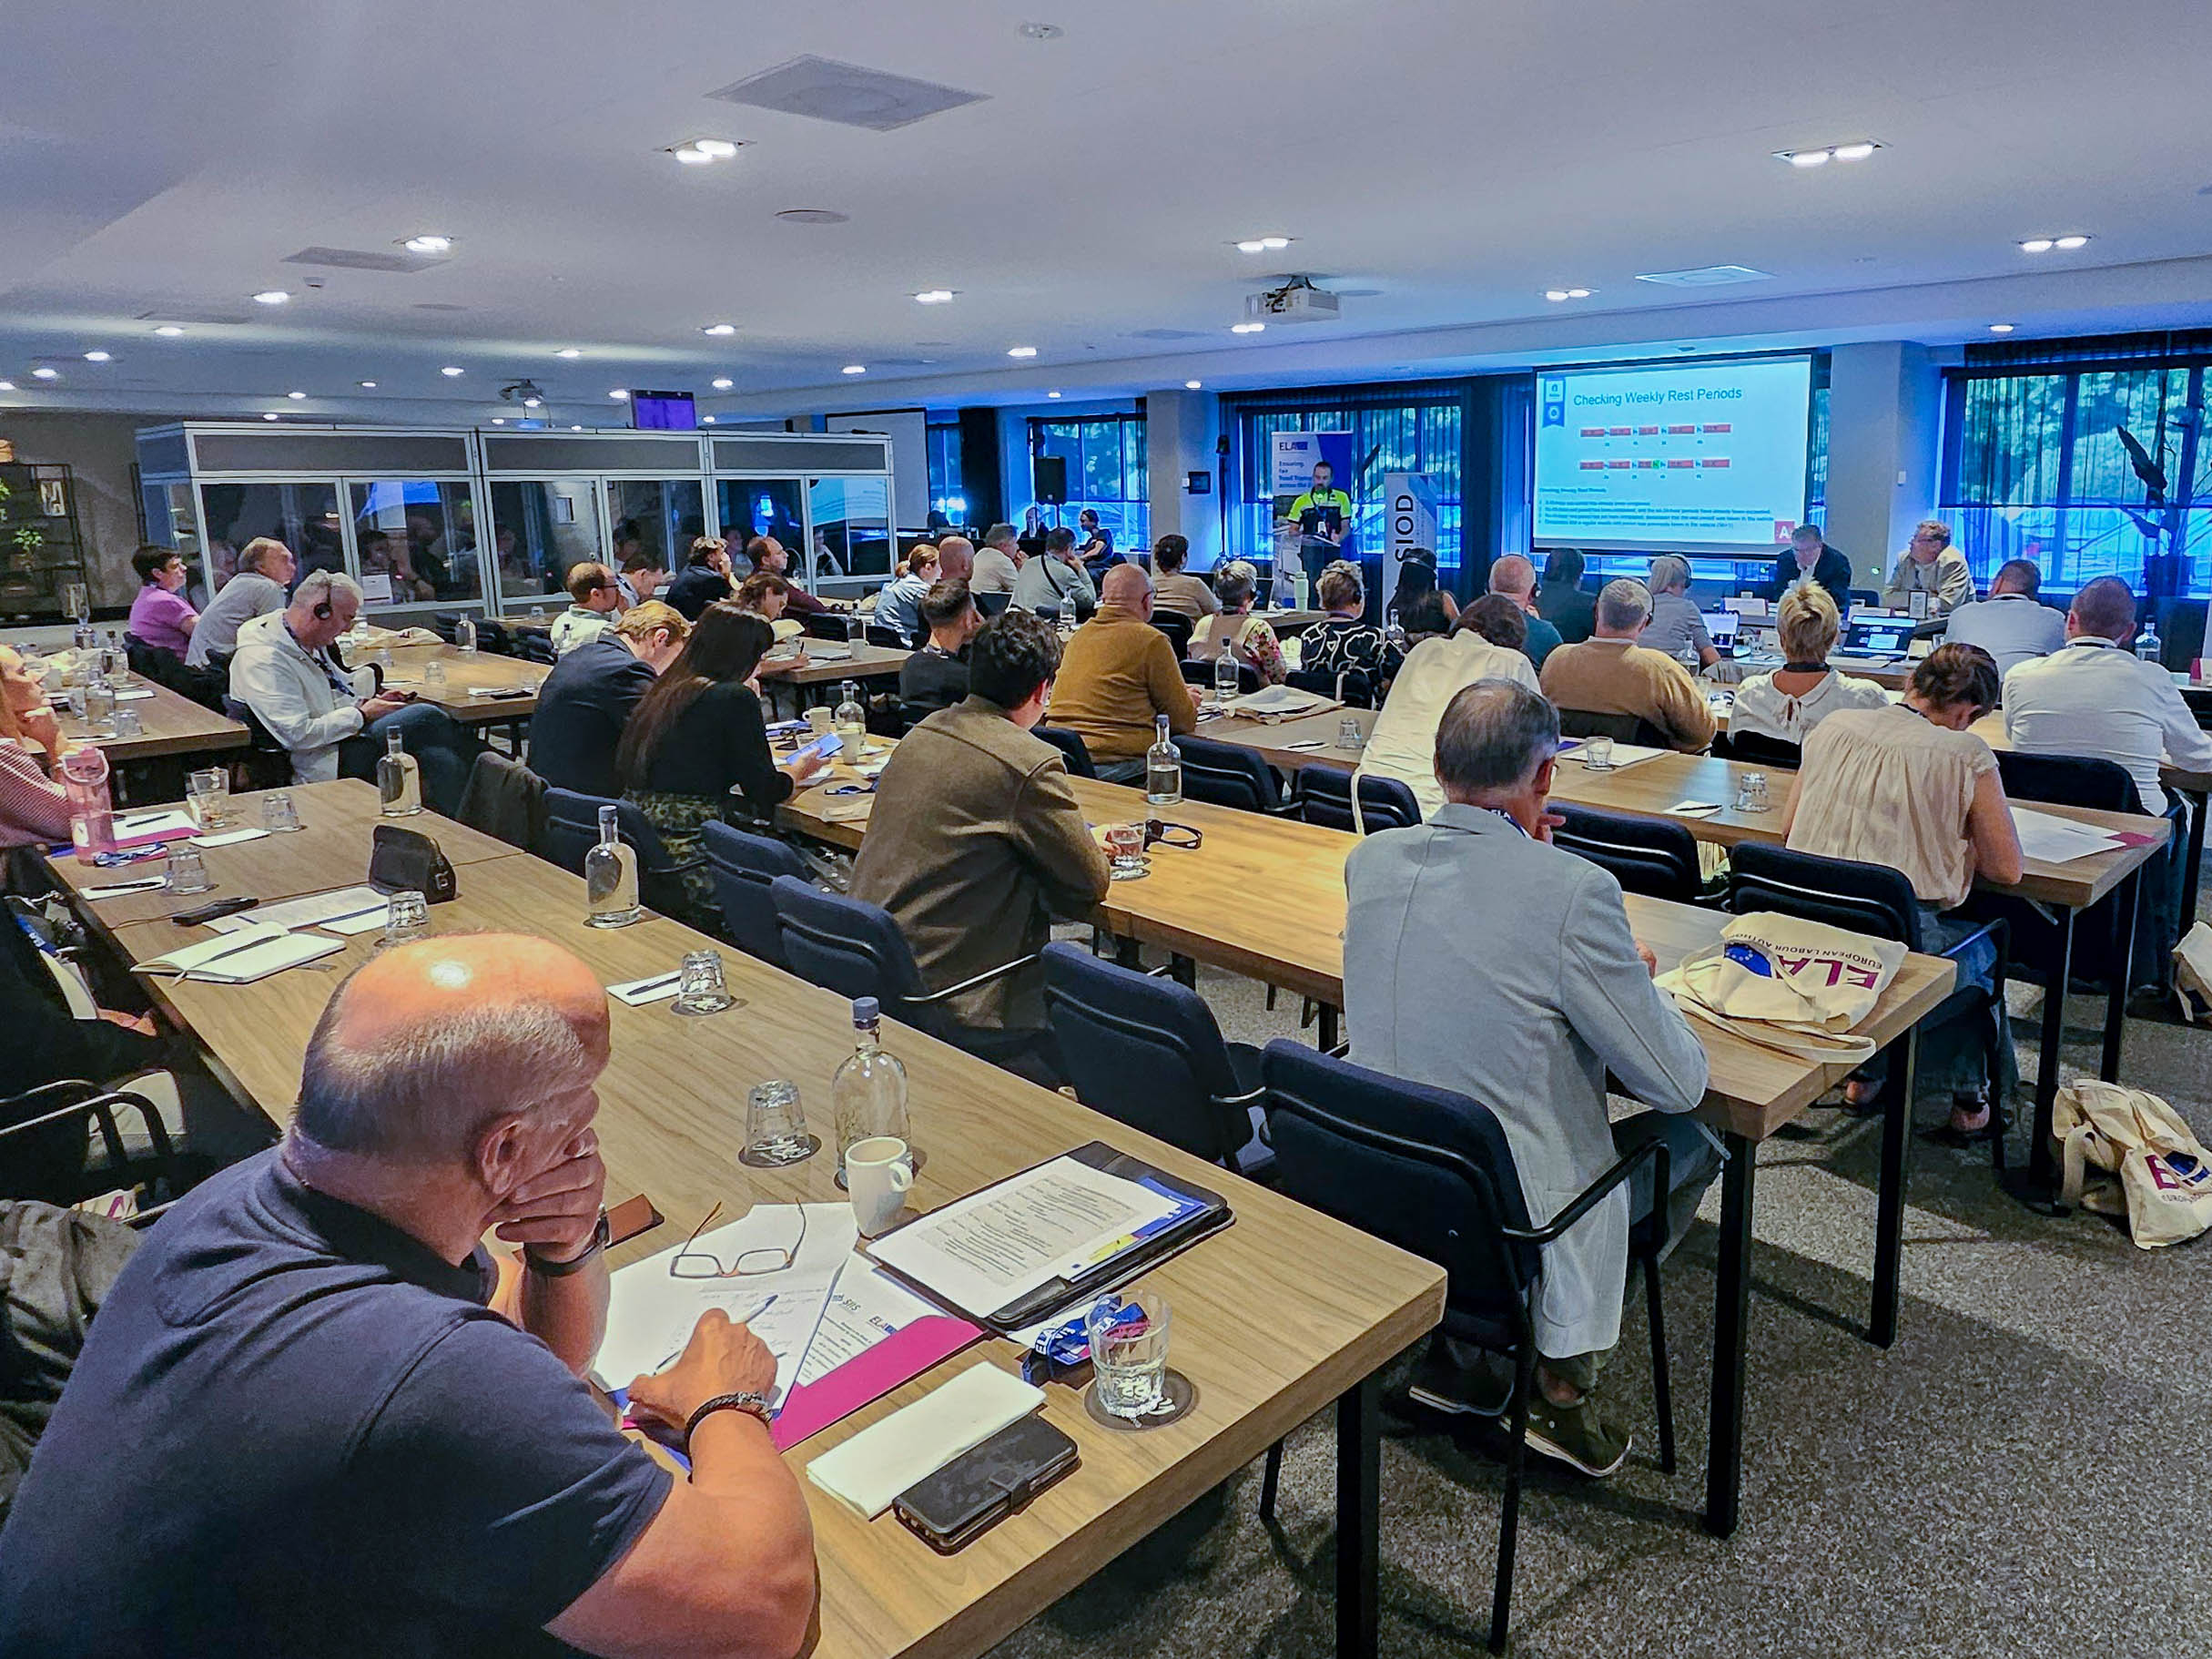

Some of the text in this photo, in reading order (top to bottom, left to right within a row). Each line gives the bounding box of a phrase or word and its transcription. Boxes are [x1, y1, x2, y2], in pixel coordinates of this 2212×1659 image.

[1573, 394, 1622, 407] Checking
[1625, 392, 1665, 405] Weekly
[1668, 390, 1693, 402] Rest
[1697, 387, 1742, 401] Periods
[1279, 442, 1297, 451] ELA
[1395, 494, 1414, 562] SIOD
[1775, 945, 1820, 955] LABOUR
[1822, 951, 1882, 970] EUROPEAN
[1775, 954, 1879, 990] ELA
